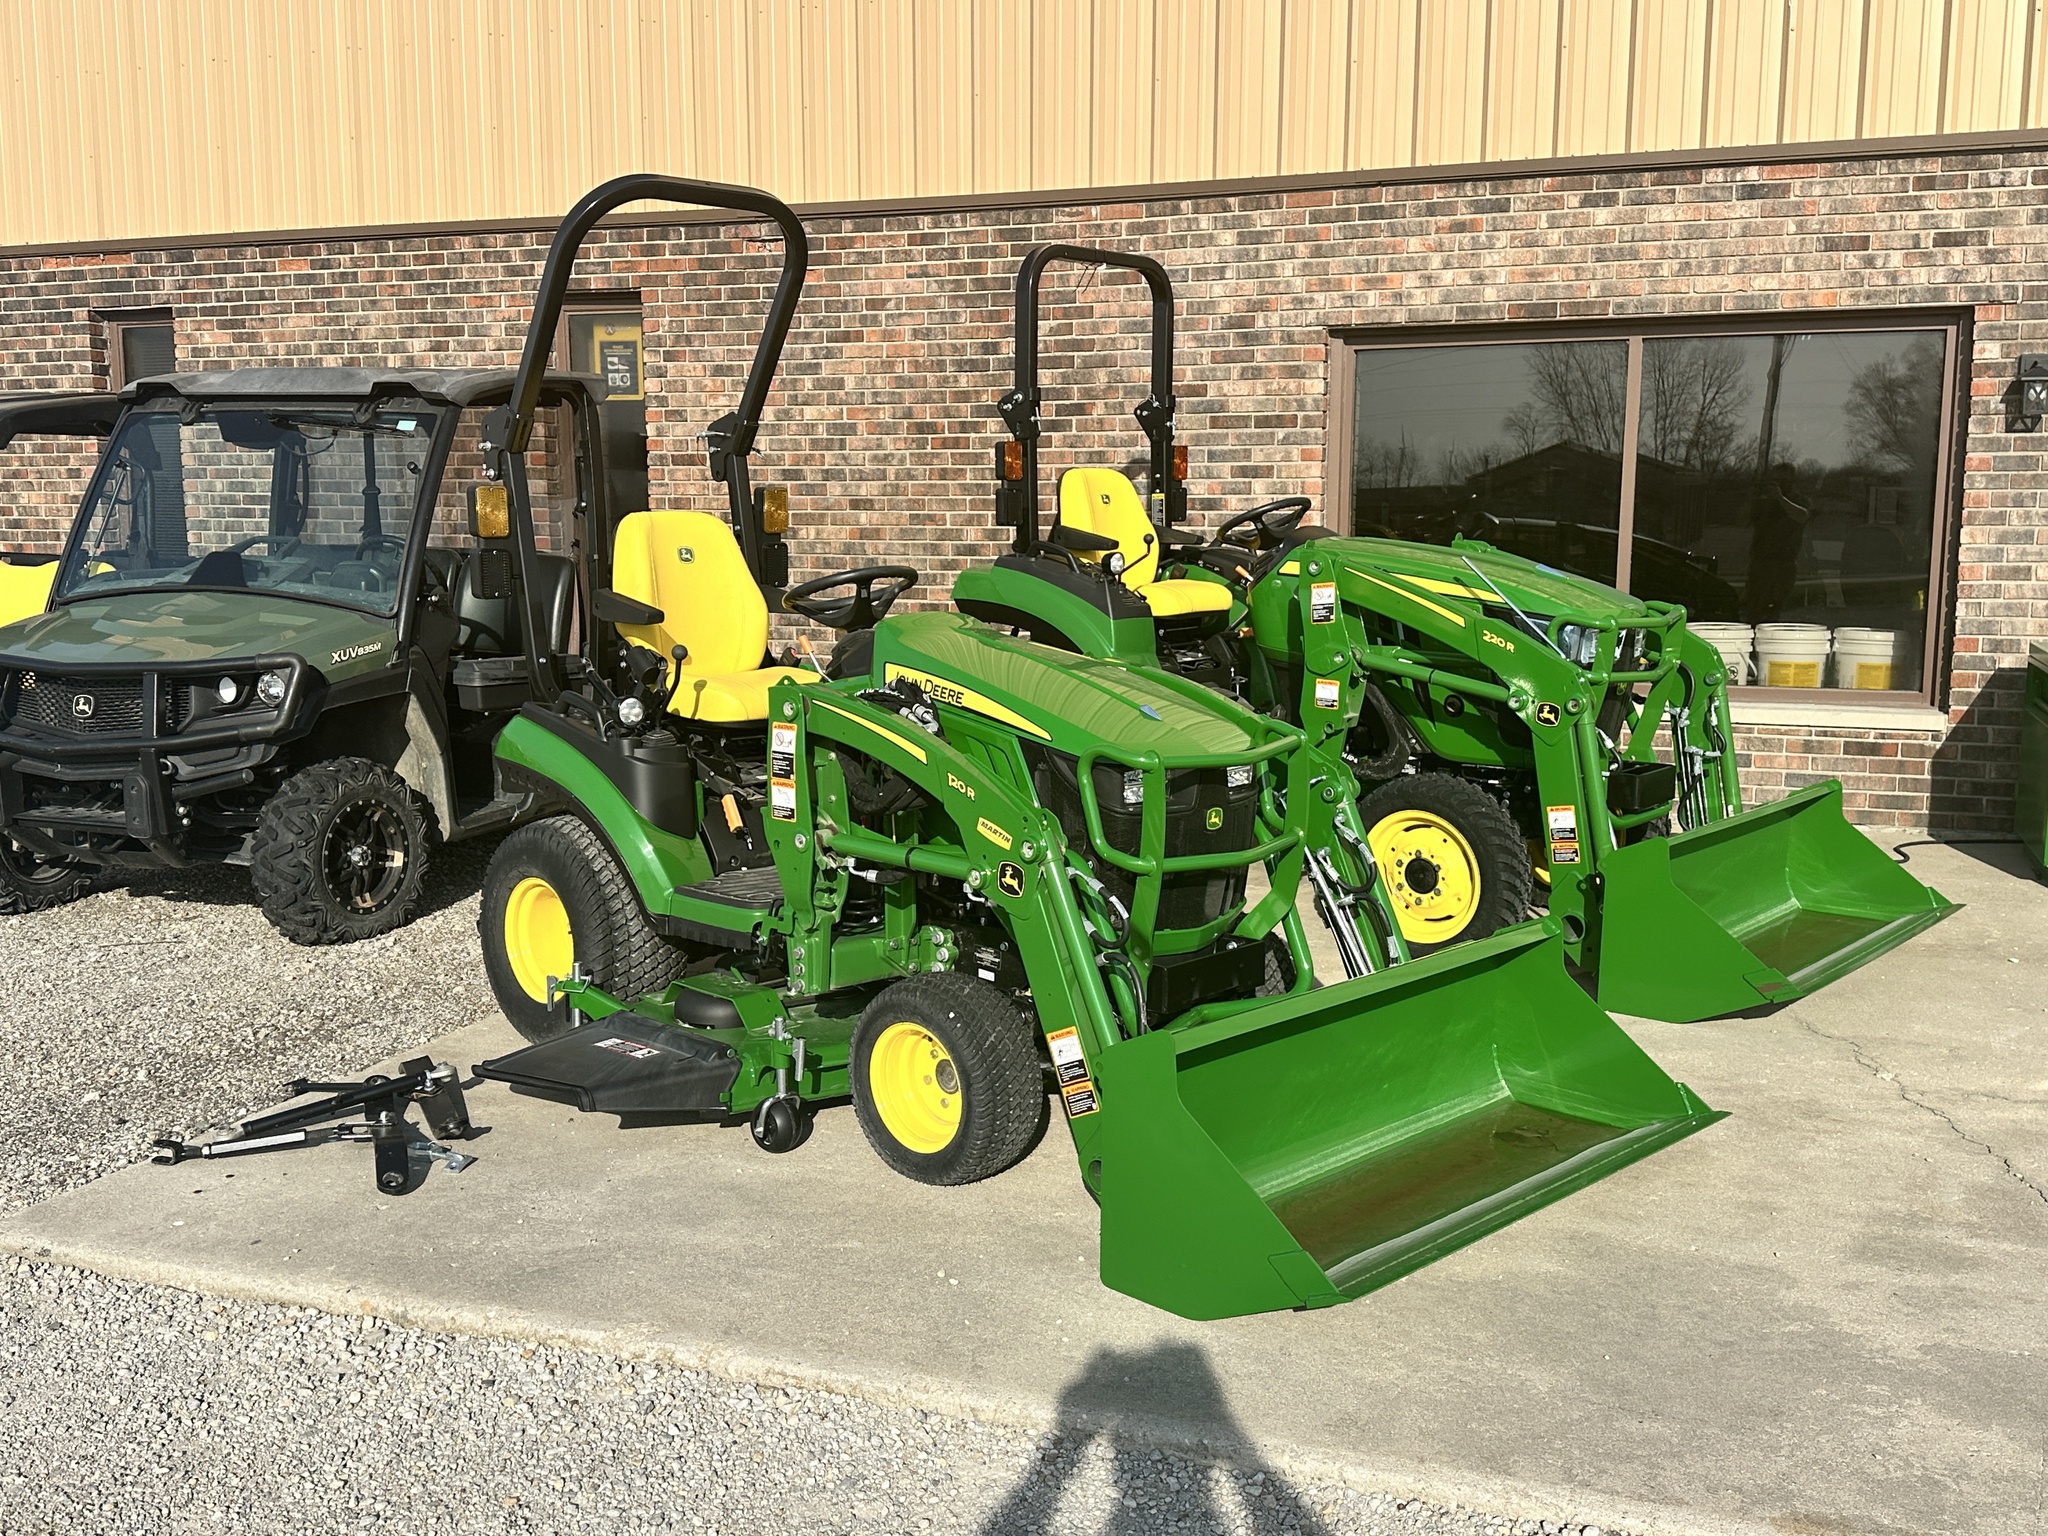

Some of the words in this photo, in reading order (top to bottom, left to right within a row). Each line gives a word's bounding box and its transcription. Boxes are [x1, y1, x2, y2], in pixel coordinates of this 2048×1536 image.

[1482, 629, 1505, 648] 220
[1506, 641, 1515, 653] R
[923, 678, 964, 705] DEERE
[947, 772, 966, 794] 120
[966, 788, 976, 801] R
[980, 820, 1012, 844] MARTIN
